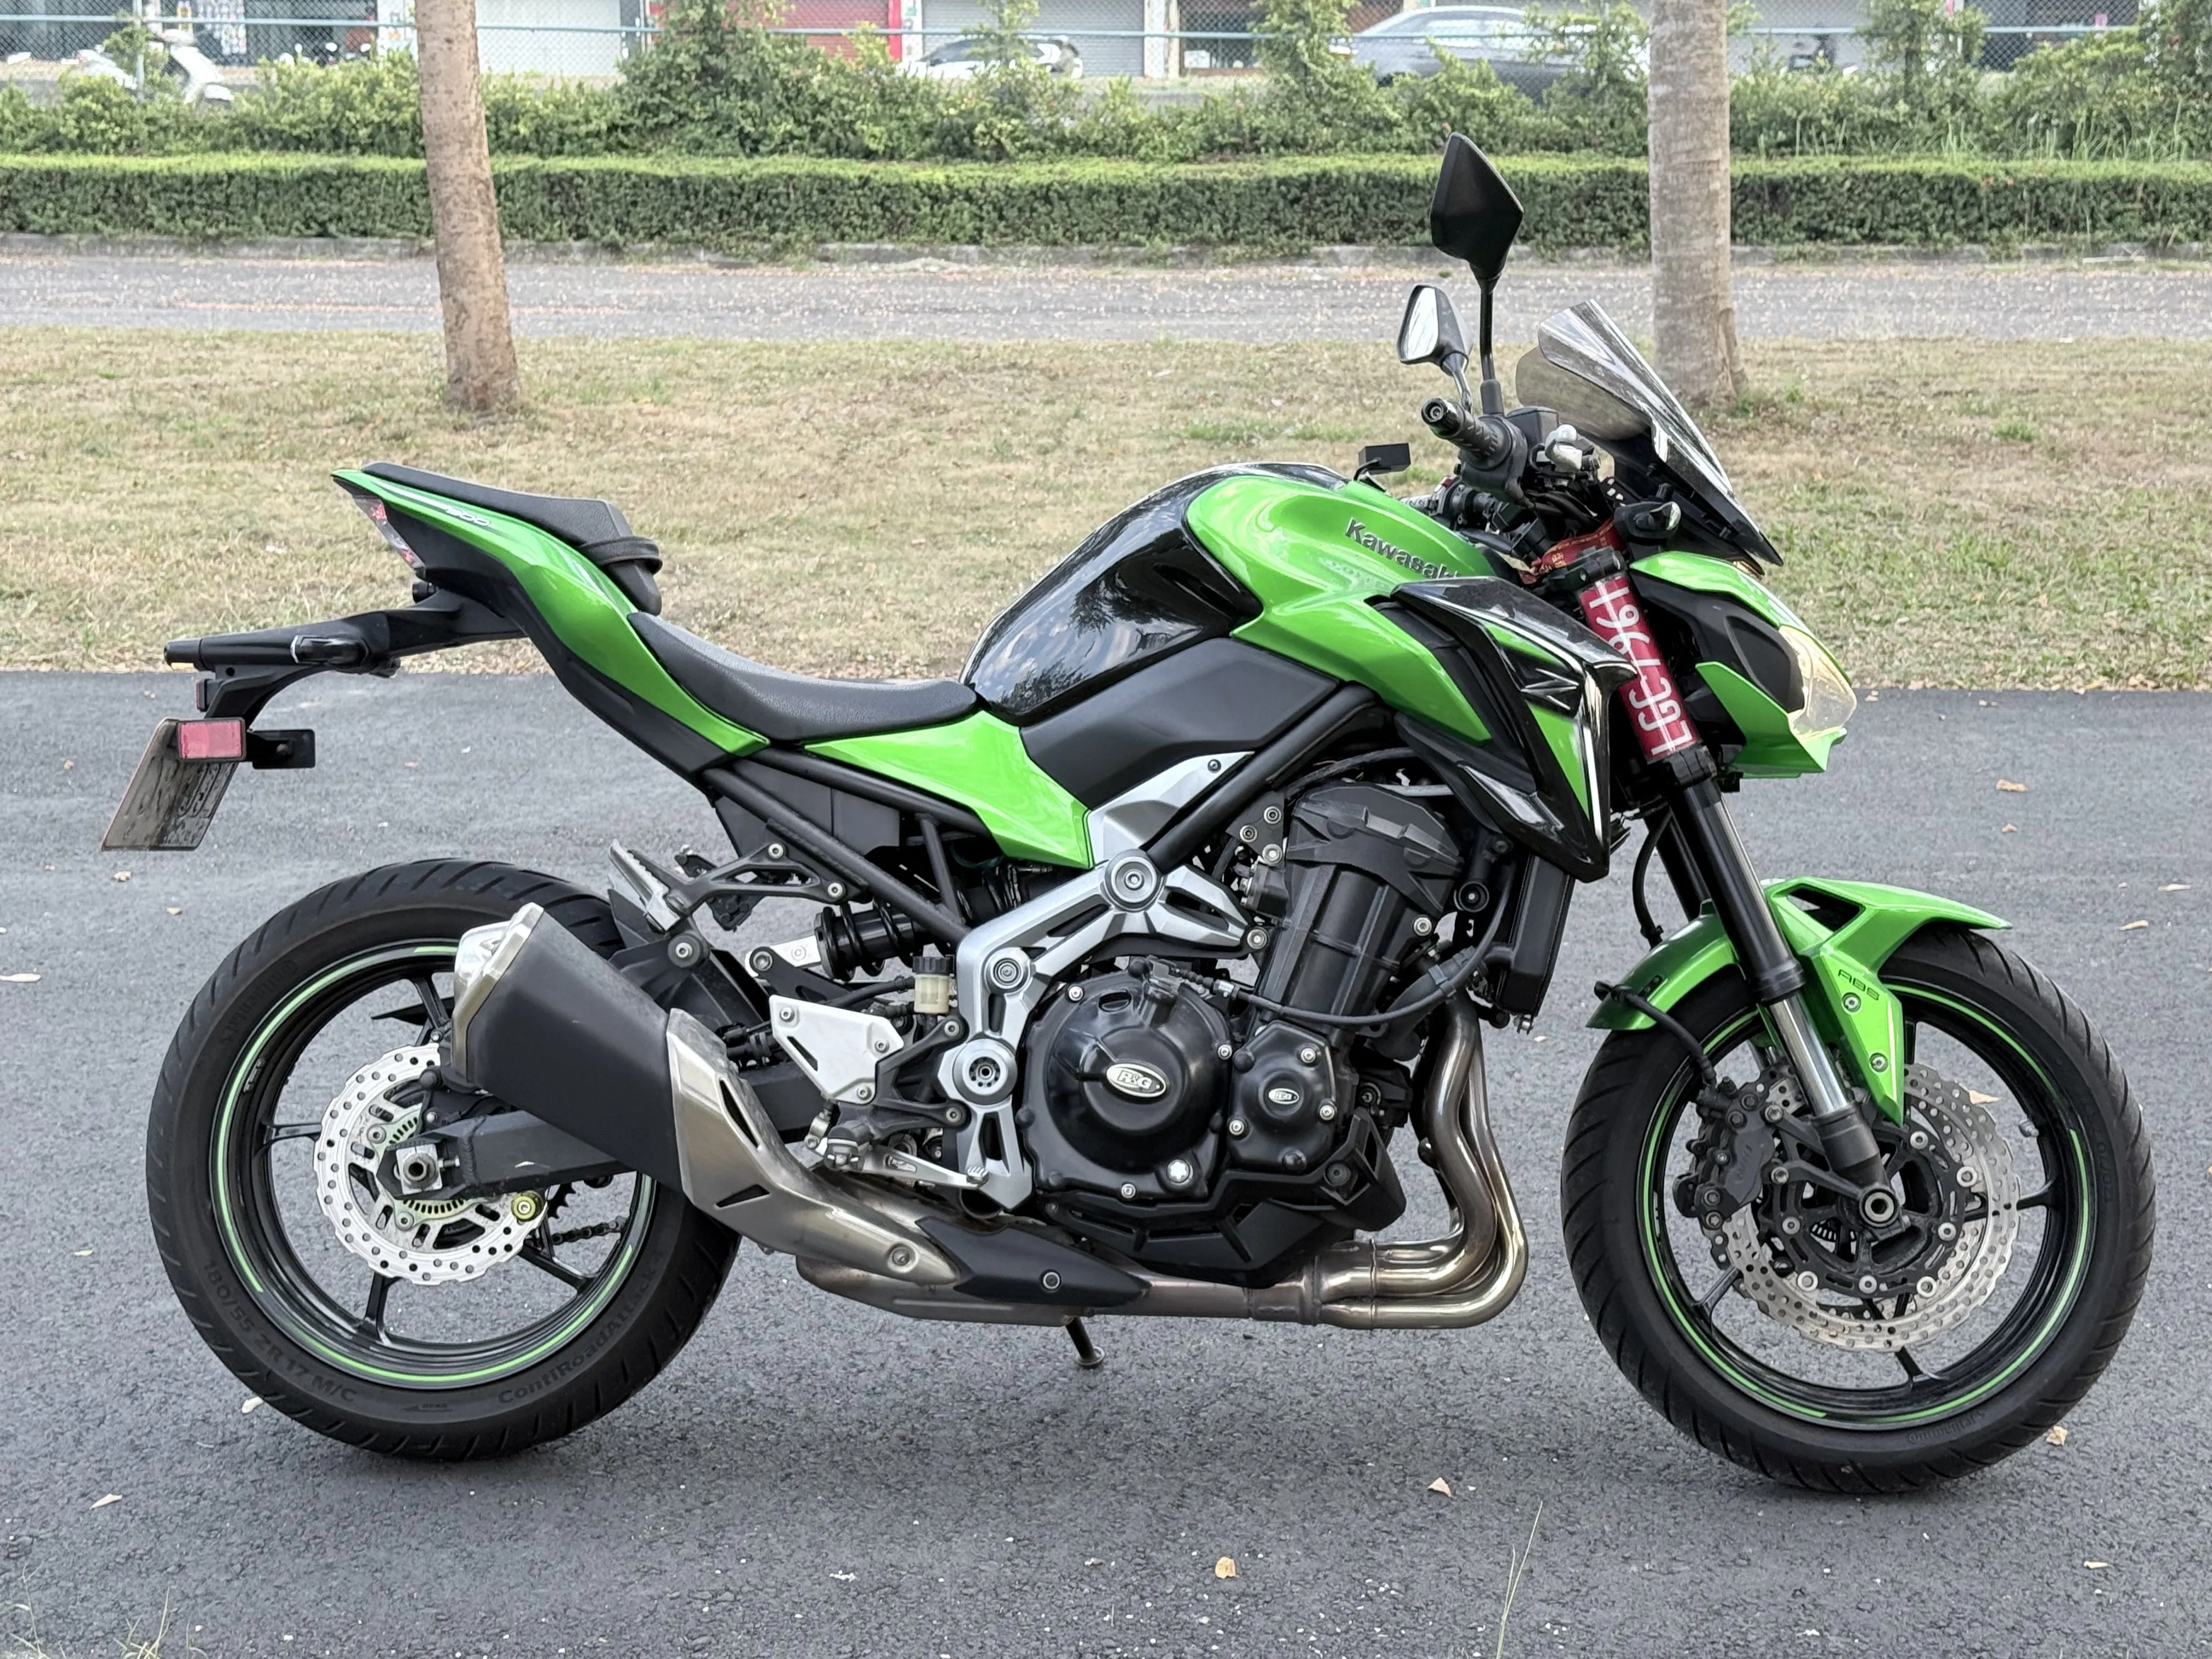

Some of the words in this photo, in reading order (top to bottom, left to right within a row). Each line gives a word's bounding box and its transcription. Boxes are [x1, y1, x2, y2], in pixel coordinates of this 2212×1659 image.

[1345, 517, 1460, 579] Kawasak
[1838, 969, 1880, 1001] ABS
[1117, 1070, 1153, 1090] R&G
[204, 1261, 256, 1333] 180/55
